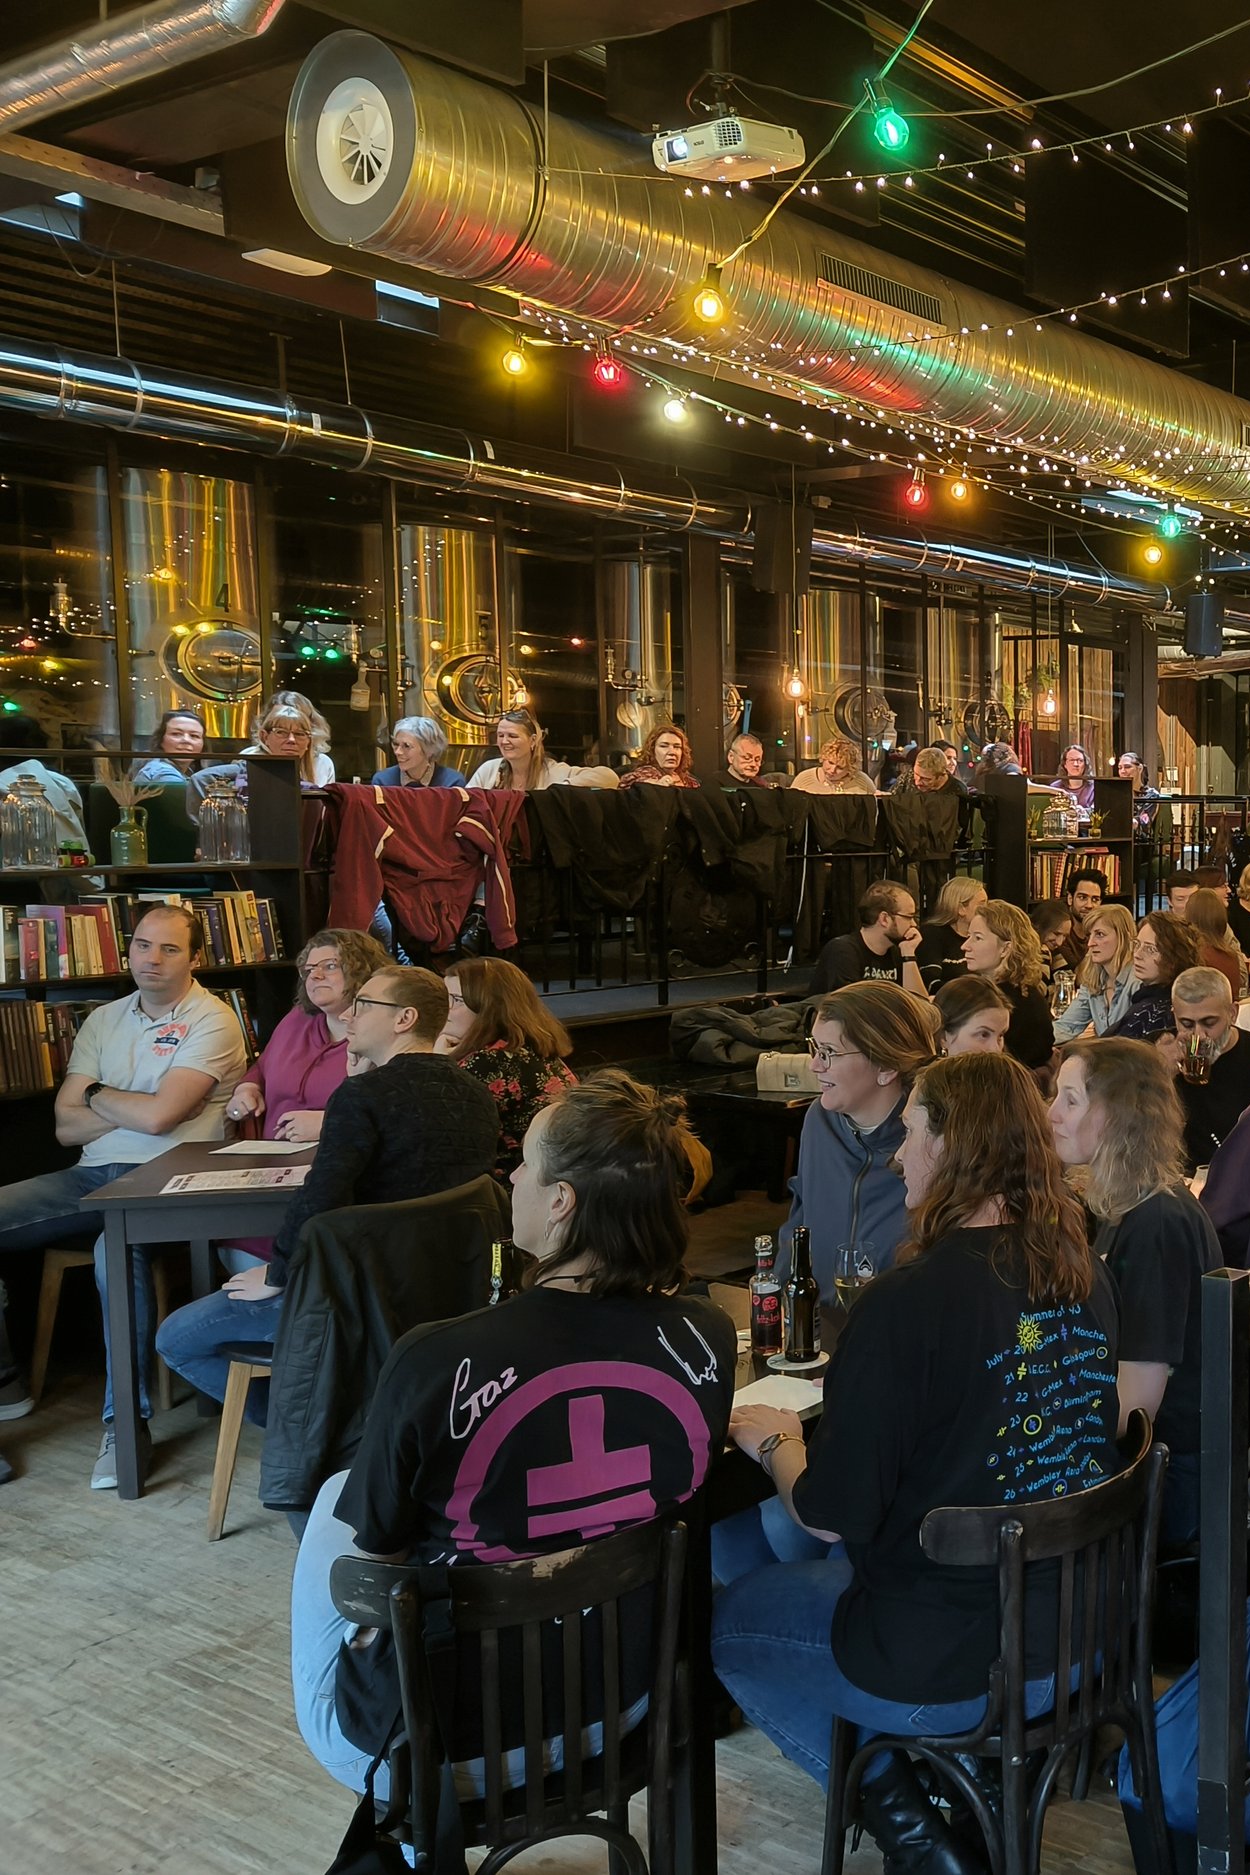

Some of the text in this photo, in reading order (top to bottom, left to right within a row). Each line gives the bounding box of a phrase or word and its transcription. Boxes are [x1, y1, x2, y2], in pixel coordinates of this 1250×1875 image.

[216, 583, 231, 613] 4
[985, 1352, 1005, 1370] July
[1004, 1371, 1016, 1386] 21
[1062, 1347, 1096, 1366] Glasgow
[1014, 1392, 1029, 1403] 22
[1014, 1462, 1026, 1478] 25
[1003, 1488, 1016, 1501] 26
[1025, 1470, 1062, 1493] Wembley
